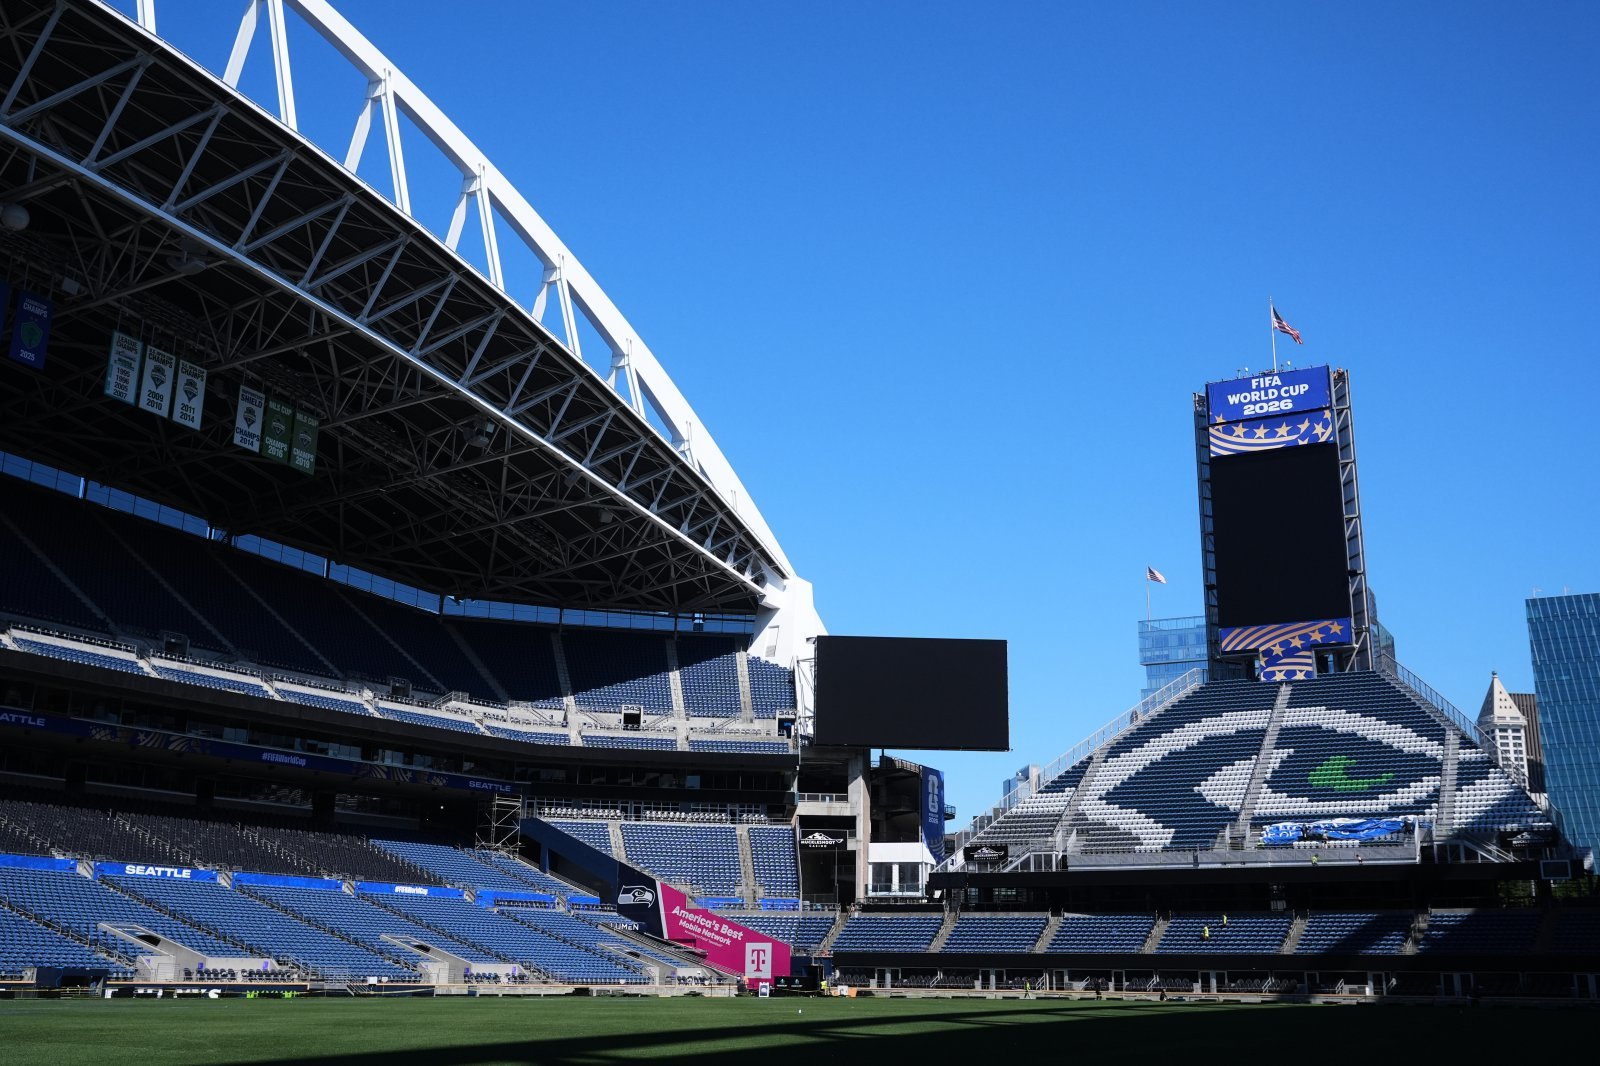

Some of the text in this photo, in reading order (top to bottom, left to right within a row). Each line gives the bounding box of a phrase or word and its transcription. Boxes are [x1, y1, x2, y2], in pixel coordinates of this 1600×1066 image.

[23, 302, 48, 318] CHAMPS
[116, 341, 138, 354] CHAMPS
[19, 349, 36, 362] 2025
[148, 353, 173, 368] CHAMPS
[116, 375, 129, 385] 1996
[180, 367, 205, 382] CHAMPS
[1251, 376, 1282, 389] FIFA
[113, 389, 127, 399] 2007
[147, 390, 164, 402] 2009
[241, 394, 263, 408] SHIELD
[1227, 384, 1309, 405] WORLD CUP
[146, 398, 162, 410] 2010
[181, 403, 195, 414] 2011
[269, 401, 293, 415] MLS CUP
[1243, 399, 1294, 416] 2026
[180, 411, 195, 423] 2014
[296, 412, 319, 427] MLS CUP
[235, 427, 260, 442] CHAMPS
[239, 436, 254, 447] 2014
[265, 437, 288, 451] CHAMPS
[268, 445, 283, 459] 2016
[293, 447, 314, 462] CHAMPS
[295, 456, 310, 469] 2019
[261, 752, 307, 767] #FIFAWorldCup
[469, 780, 512, 792] SEATTLE
[125, 864, 192, 879] SEATTLE
[671, 905, 720, 931] America's
[720, 923, 744, 940] Best
[679, 919, 702, 934] Mobile
[701, 928, 731, 945] Network
[751, 949, 766, 972] T
